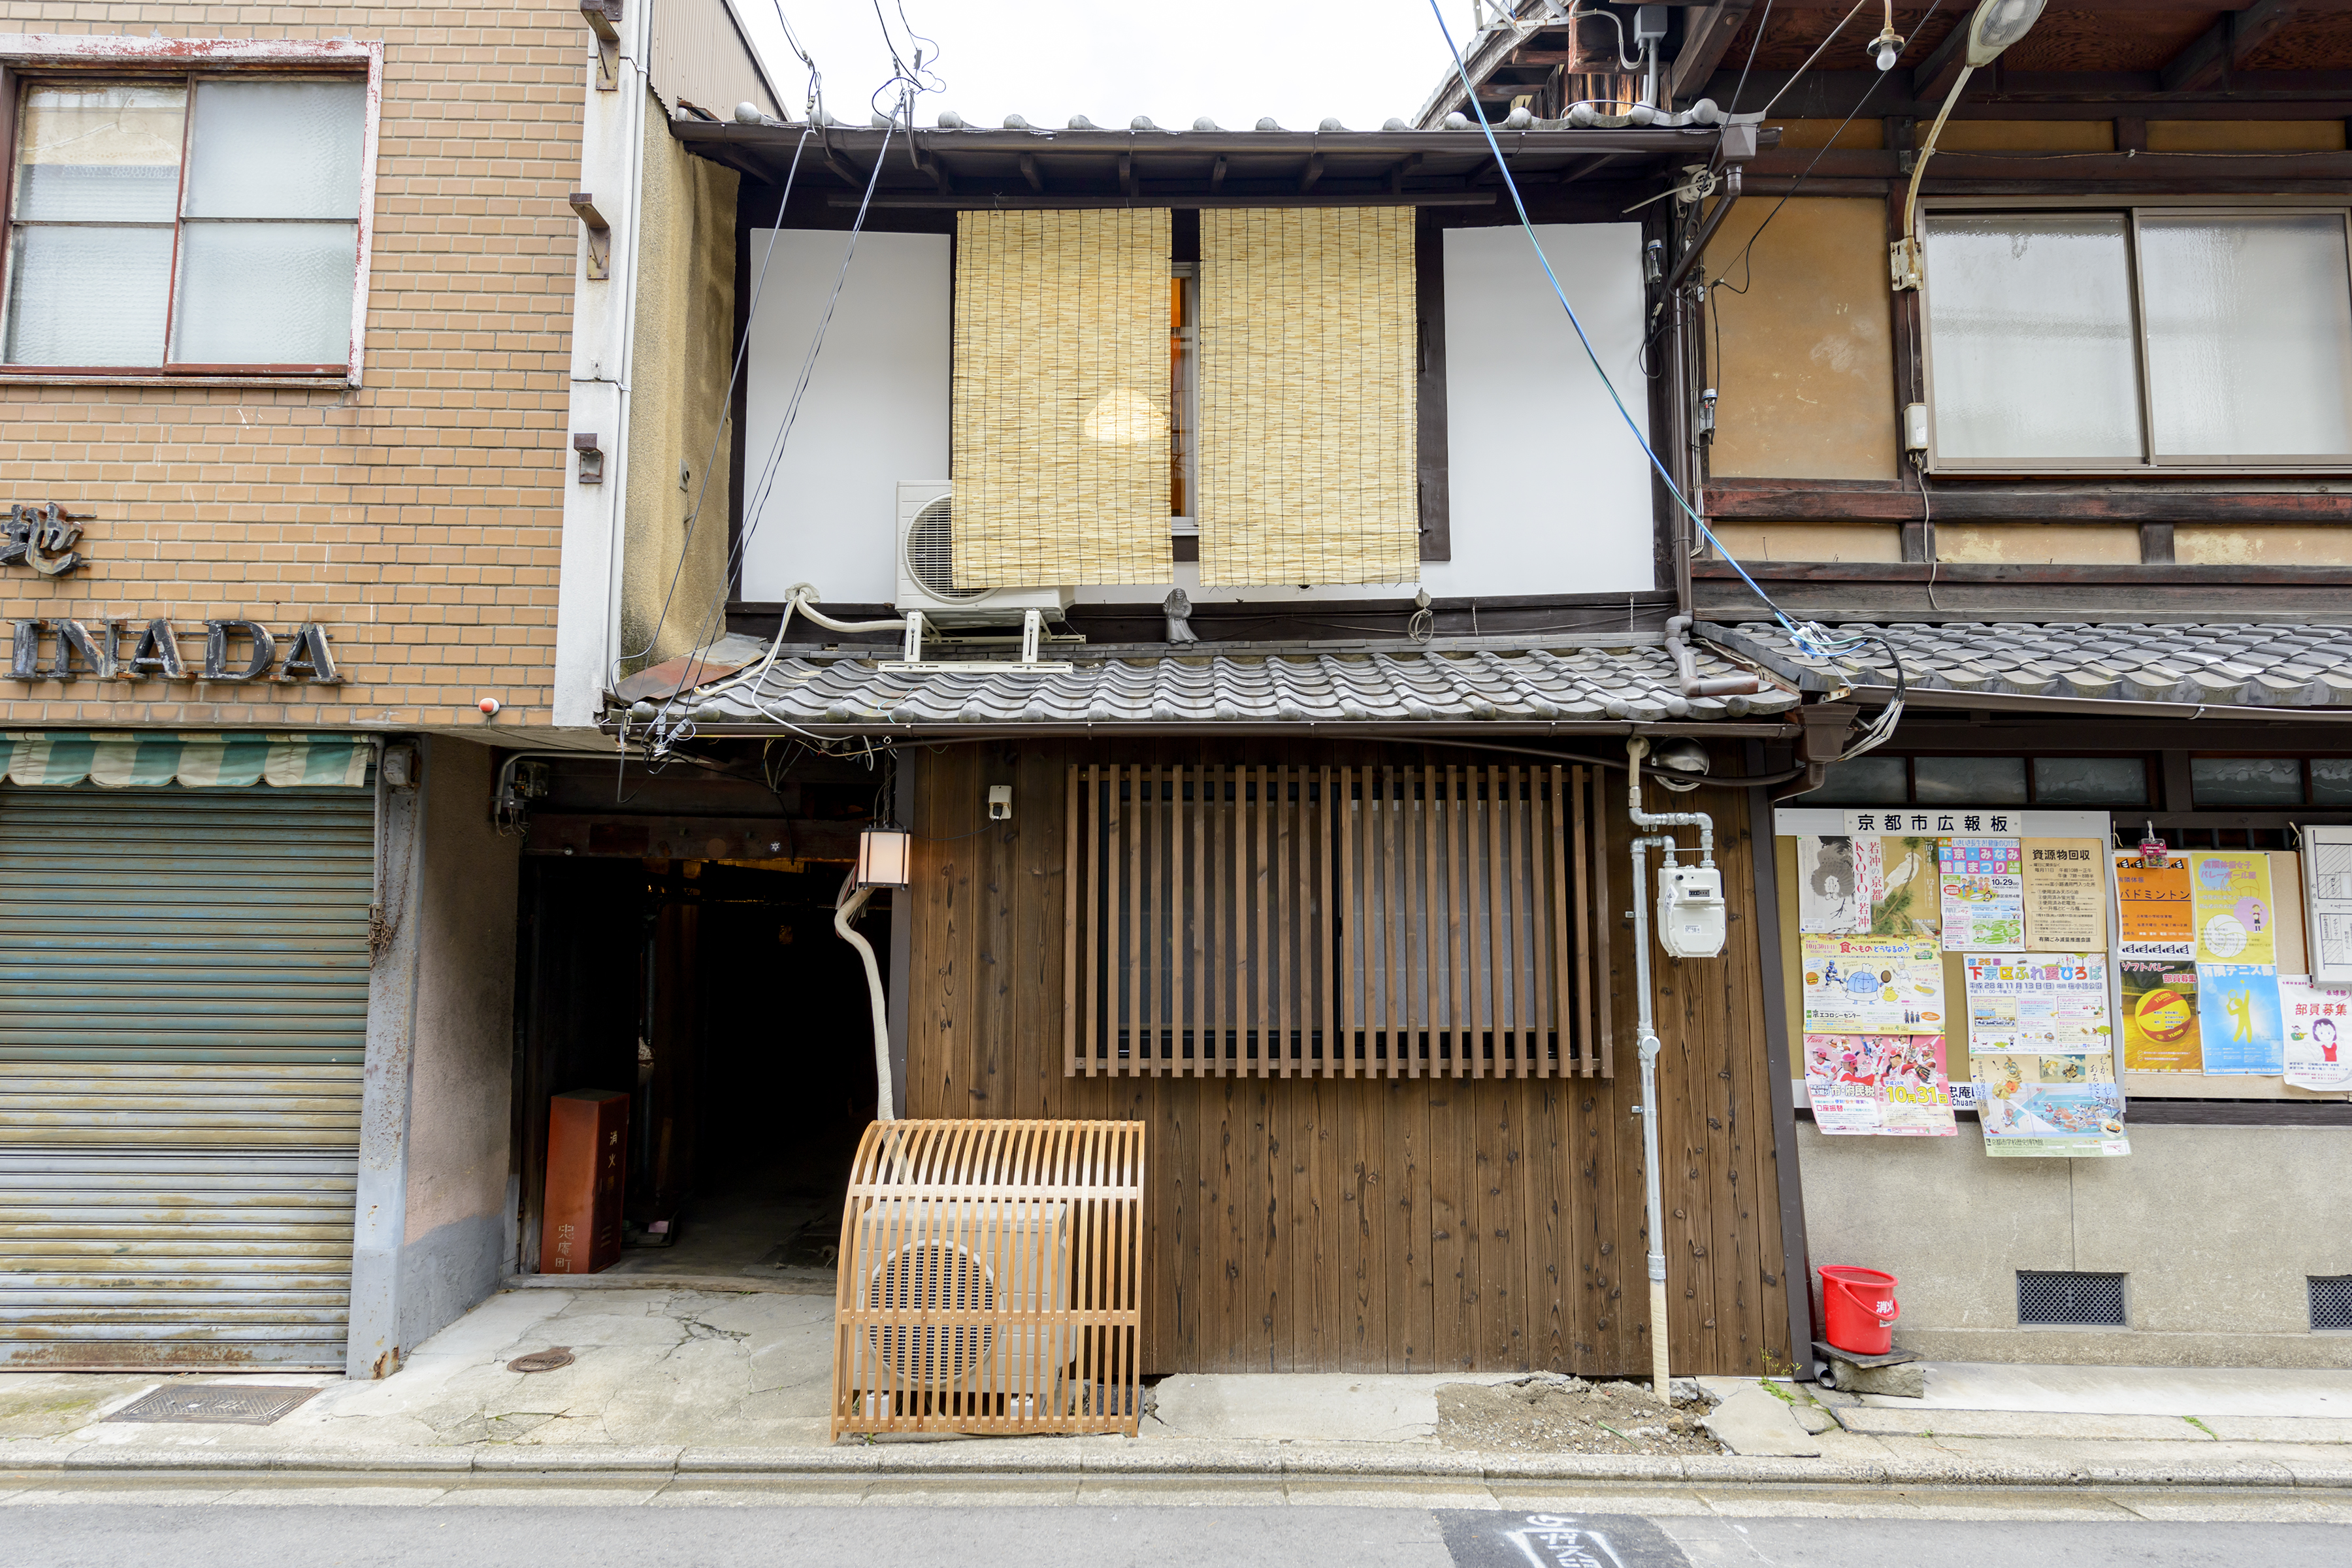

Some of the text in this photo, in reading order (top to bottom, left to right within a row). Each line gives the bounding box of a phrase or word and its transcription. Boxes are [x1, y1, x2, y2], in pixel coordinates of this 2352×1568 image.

[3, 618, 345, 683] INADA
[1857, 813, 2008, 832] 京都市広報板
[1940, 848, 2018, 860] 下京・みなみ
[2033, 849, 2090, 860] 資源物回収
[1940, 861, 2005, 873] 健康まつり
[2203, 860, 2252, 869] 有隣体振女子
[1868, 841, 1884, 901] 若冲の京都
[2201, 871, 2257, 879] バレーボール部
[1855, 841, 1870, 928] KYOTOの若冲
[2120, 889, 2190, 900] バドミントン
[1840, 941, 1910, 953] 食べもの どうなるの?
[2121, 961, 2175, 972] ソフトバレー
[2200, 965, 2274, 977] 有隣テニス部
[1968, 966, 2102, 980] 下京区ふれ愛ひろば
[2163, 974, 2197, 983] 部員募集
[2154, 992, 2171, 1003] YURIN
[2295, 1003, 2347, 1016] 部員募集
[2168, 1028, 2183, 1038] YURIN
[1831, 1085, 1875, 1097] 市・府民税
[1886, 1086, 1948, 1104] 10月31日
[1949, 1086, 1974, 1098] 忠庵
